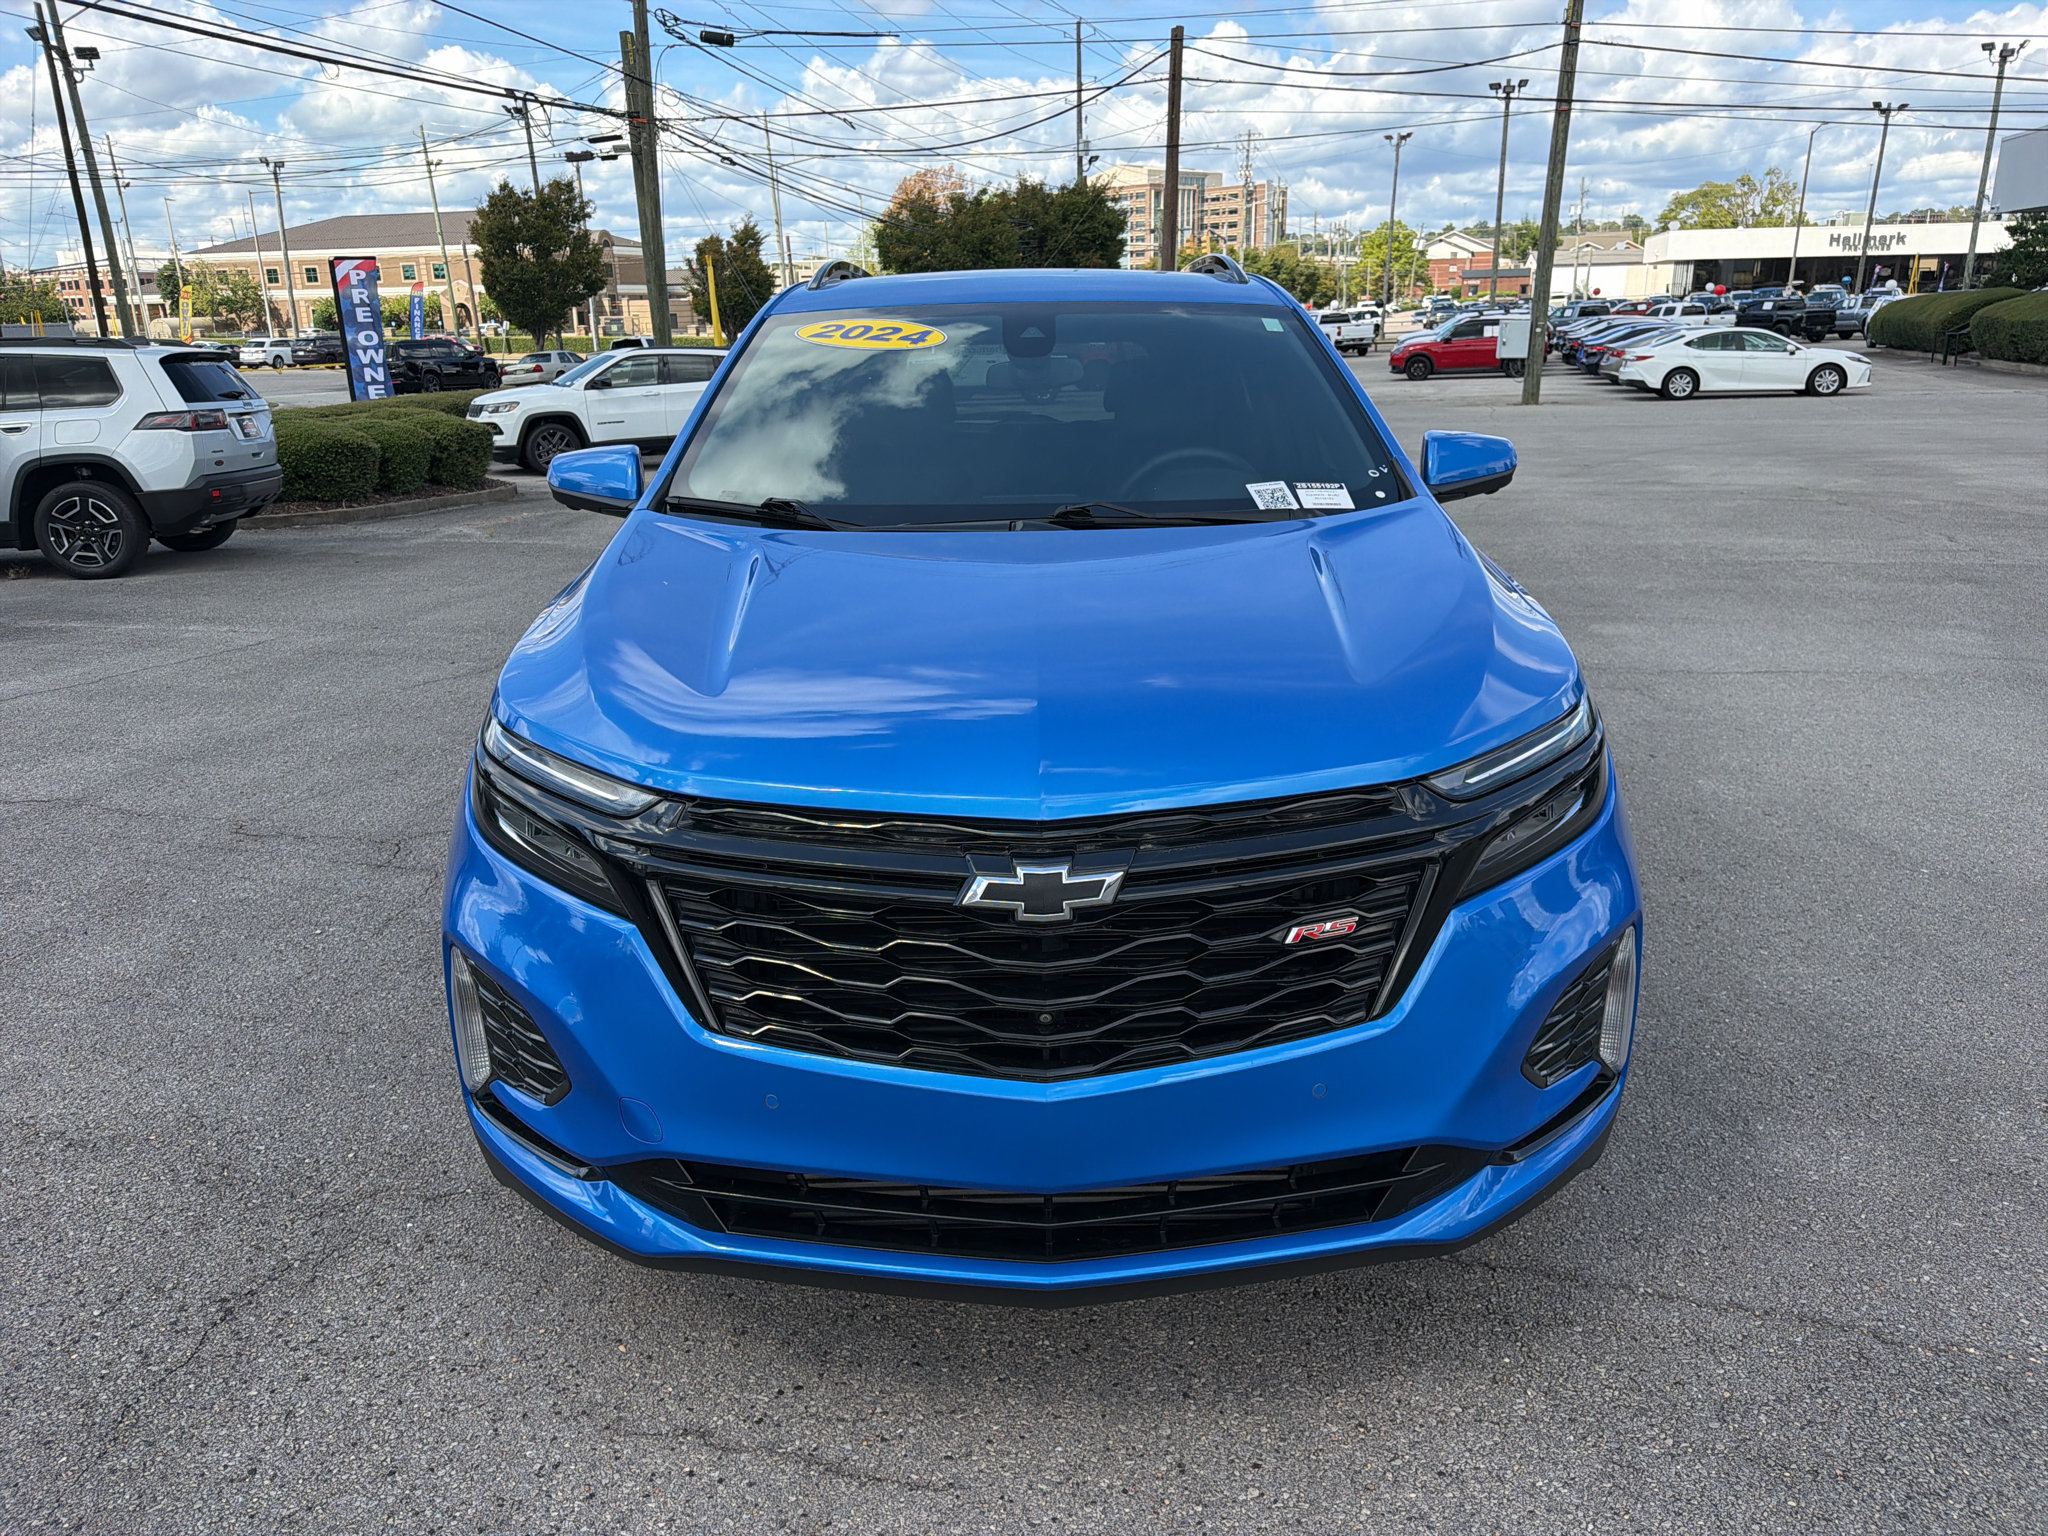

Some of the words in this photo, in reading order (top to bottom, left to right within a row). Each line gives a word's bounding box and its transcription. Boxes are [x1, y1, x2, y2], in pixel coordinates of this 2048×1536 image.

[1829, 232, 1907, 247] Hallmark
[1842, 244, 1891, 252] PRE-WNED
[348, 269, 374, 323] PRE
[806, 324, 934, 345] 2024
[1284, 917, 1359, 944] RS
